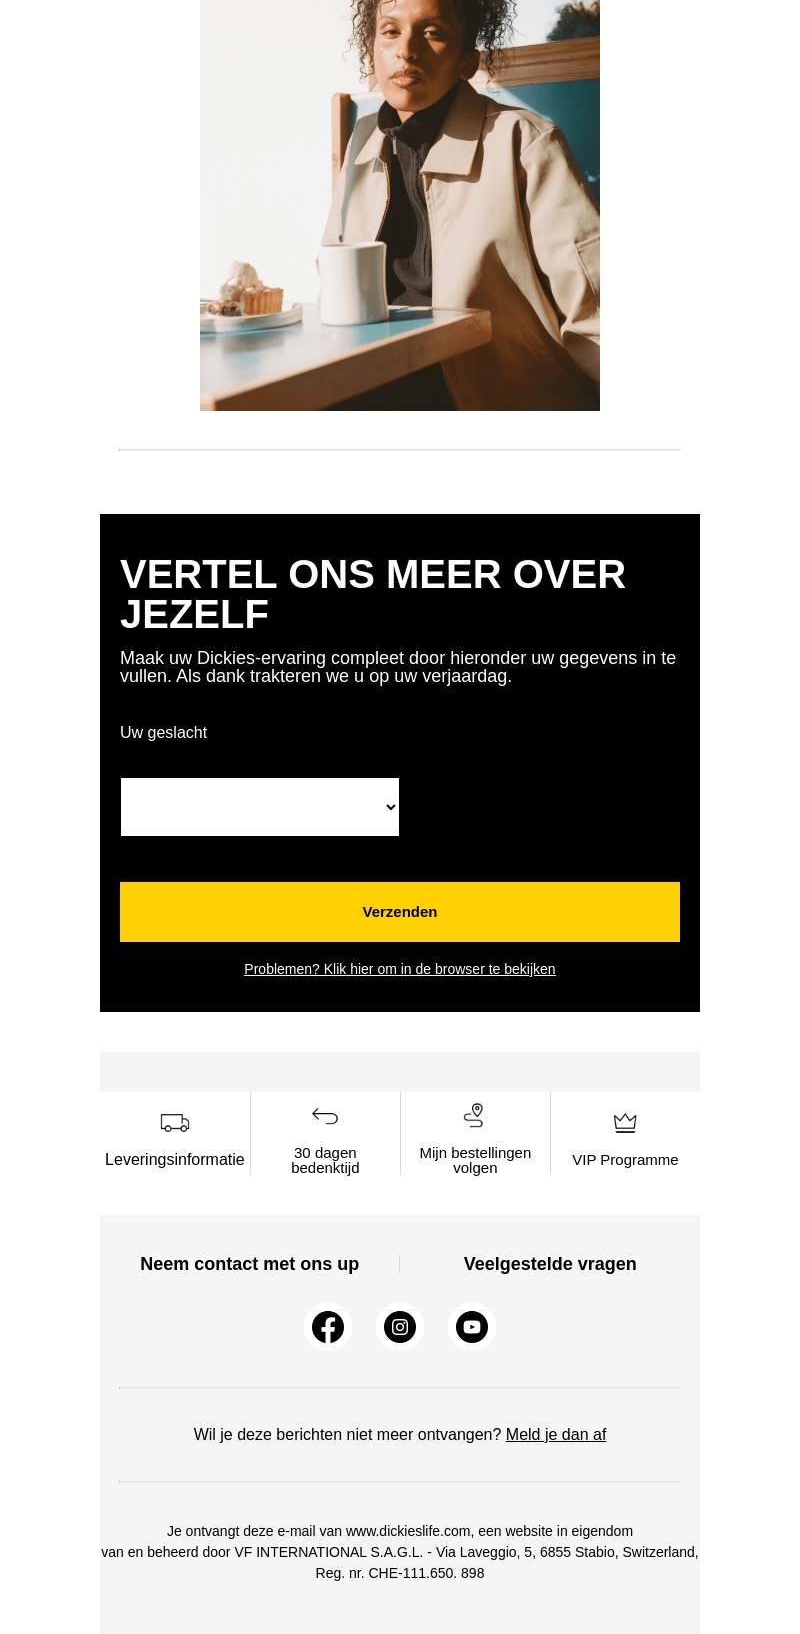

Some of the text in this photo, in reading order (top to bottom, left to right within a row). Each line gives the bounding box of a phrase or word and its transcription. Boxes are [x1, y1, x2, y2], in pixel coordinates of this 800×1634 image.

[119, 559, 626, 589] VERTEL ONS MEER OVER
[119, 599, 269, 629] JEZELF
[120, 650, 677, 669] Maak uw Dickies-ervaring compleet door hieronder uw gegevens in te
[119, 668, 512, 687] vullen. Als dank trakteren we u op uw verjaardag.
[120, 725, 208, 742] Uw geslacht
[361, 905, 438, 918] Verzenden
[244, 962, 556, 978] Problemen? Klik hier om in de browser te bekijken
[105, 1152, 245, 1169] Leveringsinformatie
[293, 1146, 357, 1162] 30 dagen
[419, 1146, 532, 1162] Mijn bestellingen
[571, 1154, 679, 1169] VIP Programme
[291, 1161, 360, 1177] bedenktijd
[452, 1161, 498, 1177] volgen
[140, 1256, 360, 1275] Neem contact met ons up
[463, 1256, 637, 1275] Veelgestelde vragen
[193, 1427, 502, 1444] Wil je deze berichten niet meer ontvangen?
[506, 1427, 608, 1444] Meld je dan af
[166, 1524, 633, 1540] Je ontvangt deze e-mail van www.dickieslife.com, een website in eigendom
[100, 1548, 124, 1558] van
[127, 1548, 144, 1558] en
[147, 1545, 199, 1558] beheerd
[202, 1545, 231, 1558] door
[234, 1546, 253, 1558] VF
[256, 1546, 368, 1558] INTERNATIONAL
[370, 1546, 423, 1558] S.A.G.L.
[435, 1545, 457, 1558] Via
[460, 1545, 520, 1561] Laveggio,
[524, 1546, 536, 1560] 5,
[539, 1546, 572, 1558] 6855
[575, 1545, 619, 1560] Stabio,
[622, 1545, 699, 1560] Switzerland,
[315, 1567, 485, 1582] Reg. nr. CHE-111.650. 898
